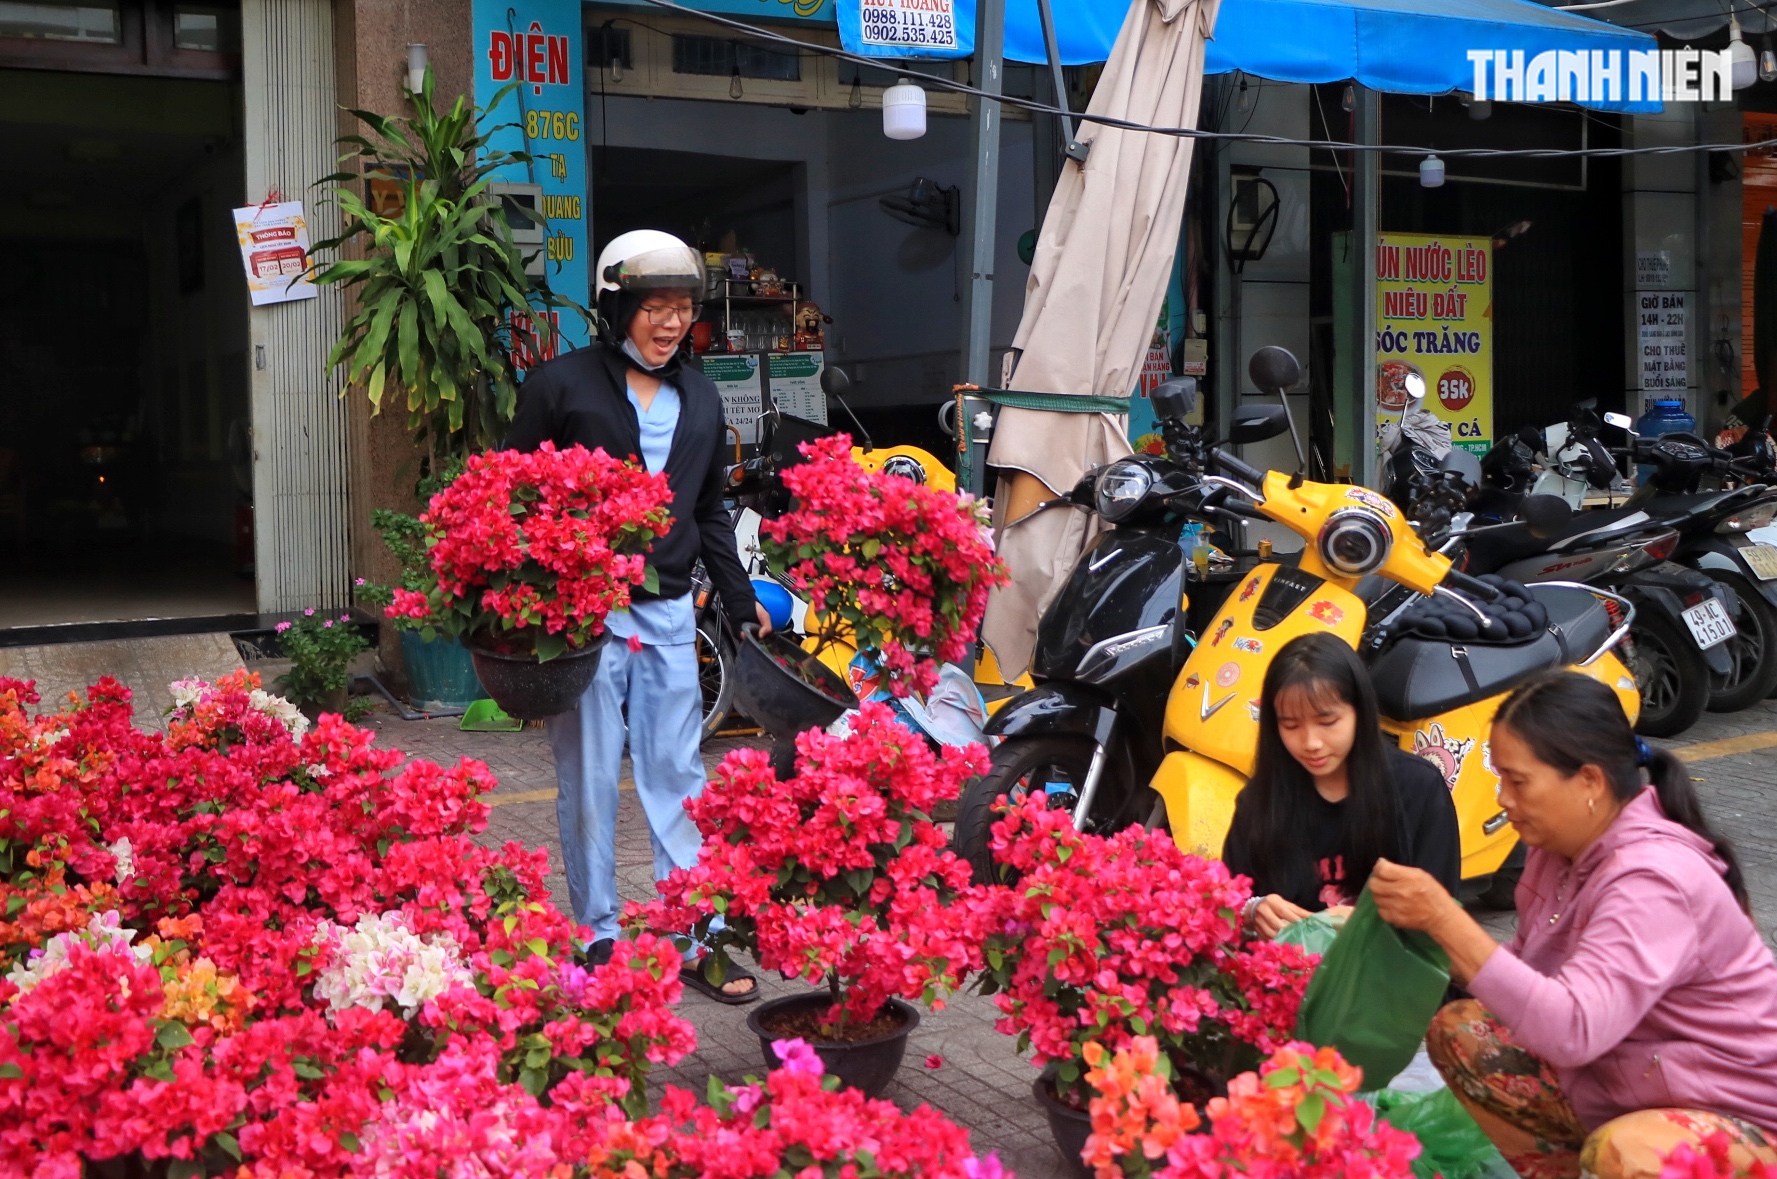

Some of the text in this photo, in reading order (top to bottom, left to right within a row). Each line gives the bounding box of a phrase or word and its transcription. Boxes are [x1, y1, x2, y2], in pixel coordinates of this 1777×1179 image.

[863, 8, 952, 29] 0988.111.428
[864, 24, 953, 45] 0902.535.425
[488, 21, 569, 95] ĐIỆN
[526, 110, 580, 141] 876C
[550, 153, 567, 183] TẠ
[259, 261, 301, 272] 17/02 20/02
[1376, 239, 1487, 282] ÚN NƯỚC LÈO
[1384, 285, 1467, 318] NIÊU ĐẤT
[1641, 294, 1684, 309] GIỜ BÁN
[1641, 313, 1659, 326] 14H
[1666, 313, 1684, 326] 22H
[1413, 324, 1481, 354] TRĂNG
[1644, 343, 1686, 356] CHO THUÊ
[732, 394, 760, 403] KHÔNG
[730, 406, 746, 414] TẾT
[735, 417, 753, 425] 24/24
[1457, 418, 1482, 437] CÁ
[1273, 577, 1306, 591] VINFAST
